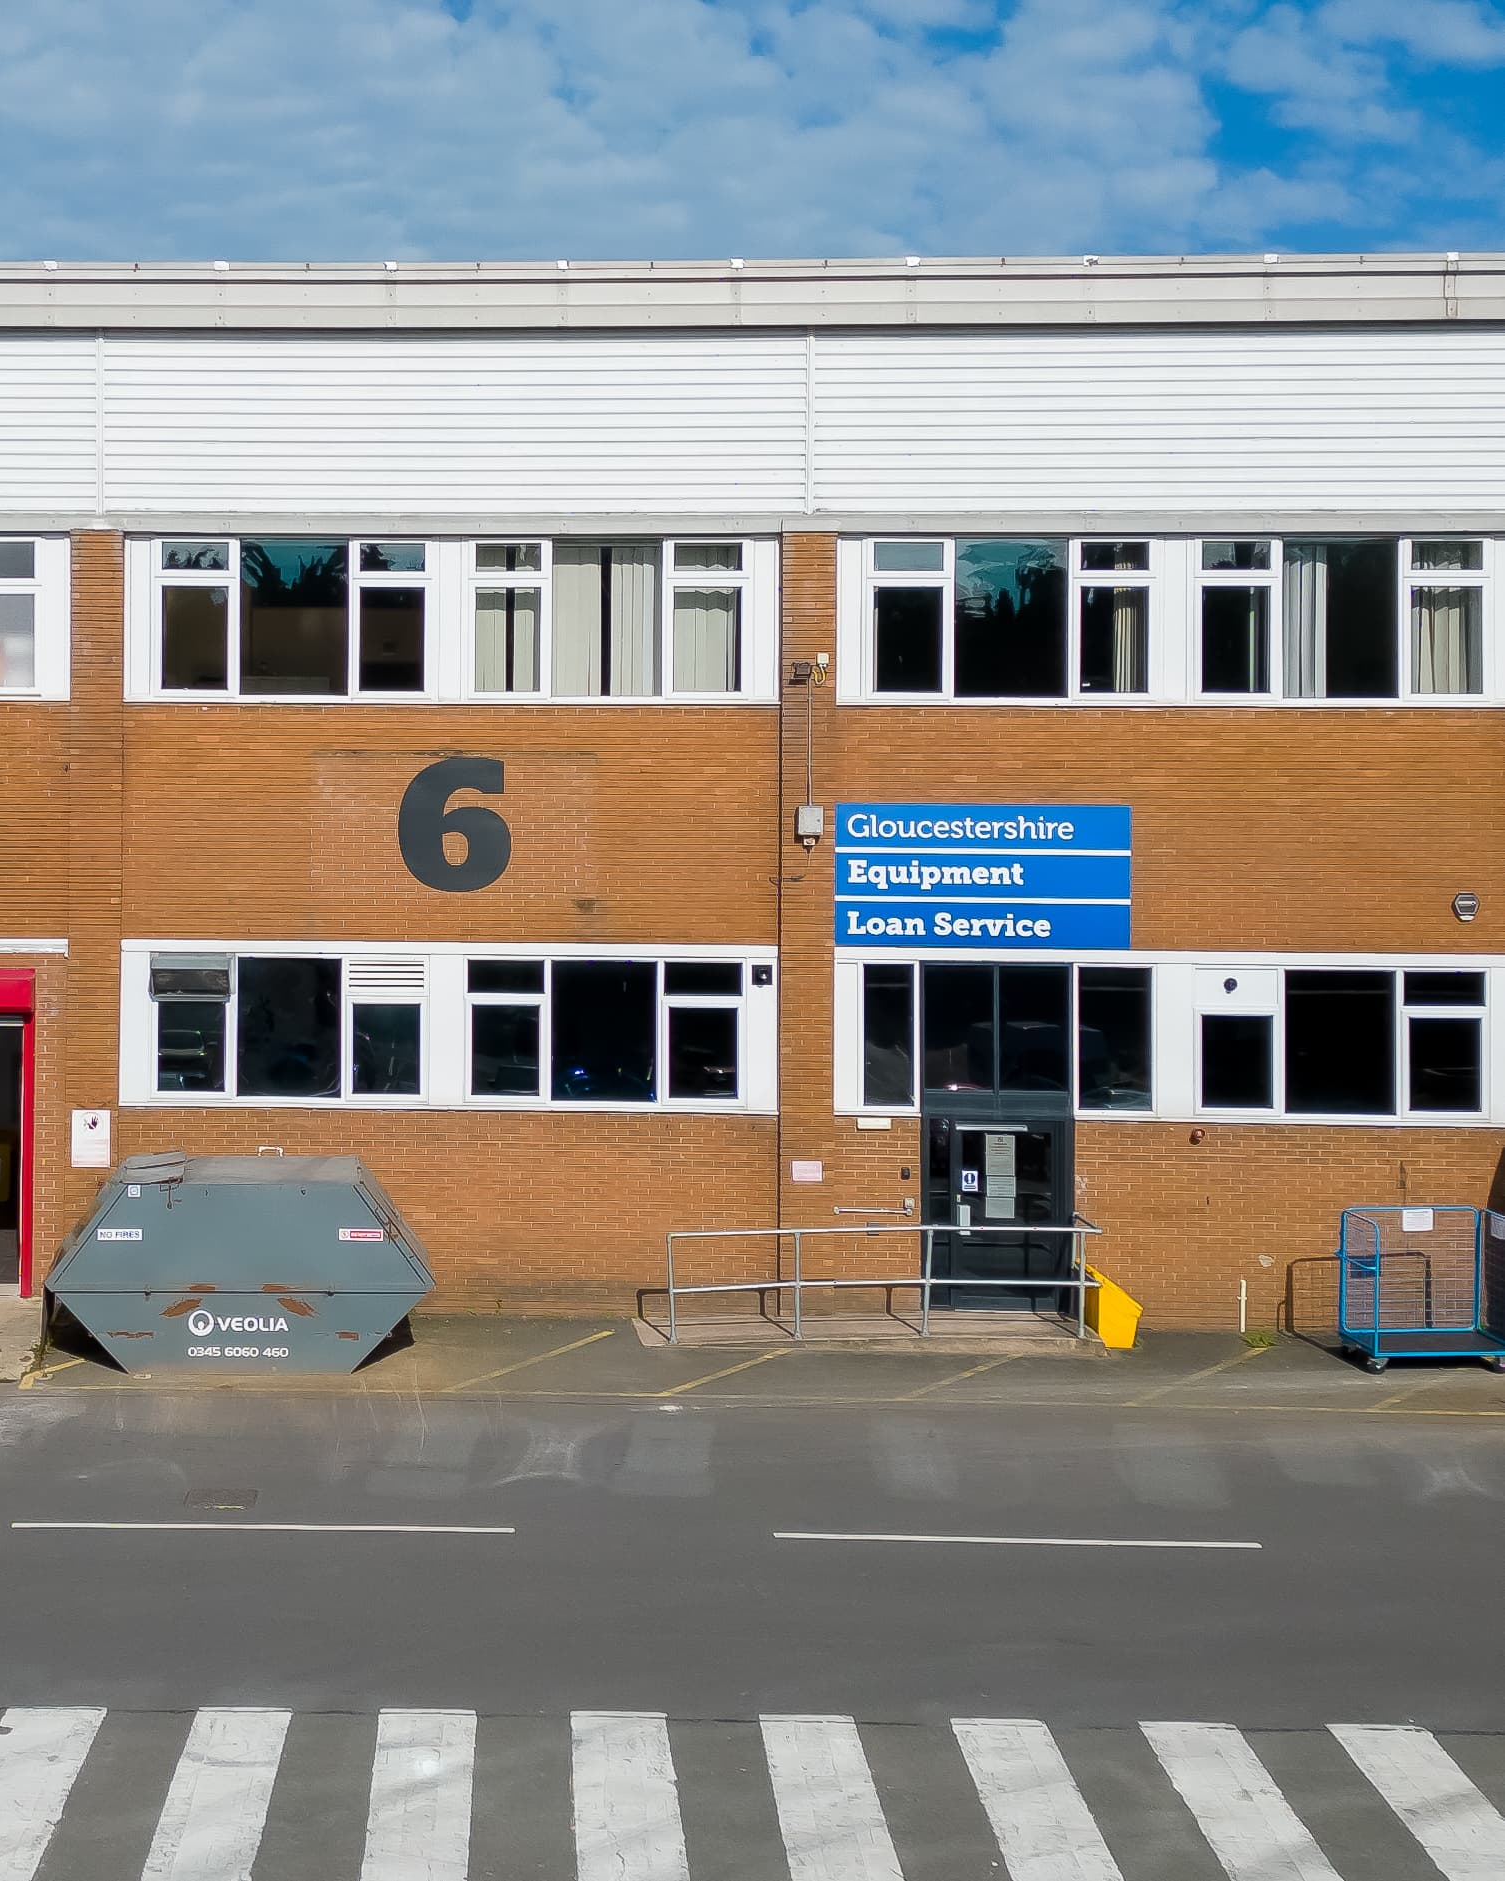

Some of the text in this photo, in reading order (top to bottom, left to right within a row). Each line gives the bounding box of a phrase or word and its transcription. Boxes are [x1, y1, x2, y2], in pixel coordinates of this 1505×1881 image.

[398, 756, 512, 892] 6
[847, 813, 1075, 840] Gloucestershire
[847, 859, 1025, 890] Equipment
[847, 910, 1052, 938] Loan Service
[99, 1230, 140, 1239] NO FIRES
[216, 1317, 289, 1332] VEOLIA
[187, 1346, 289, 1358] 0345 6060 460
